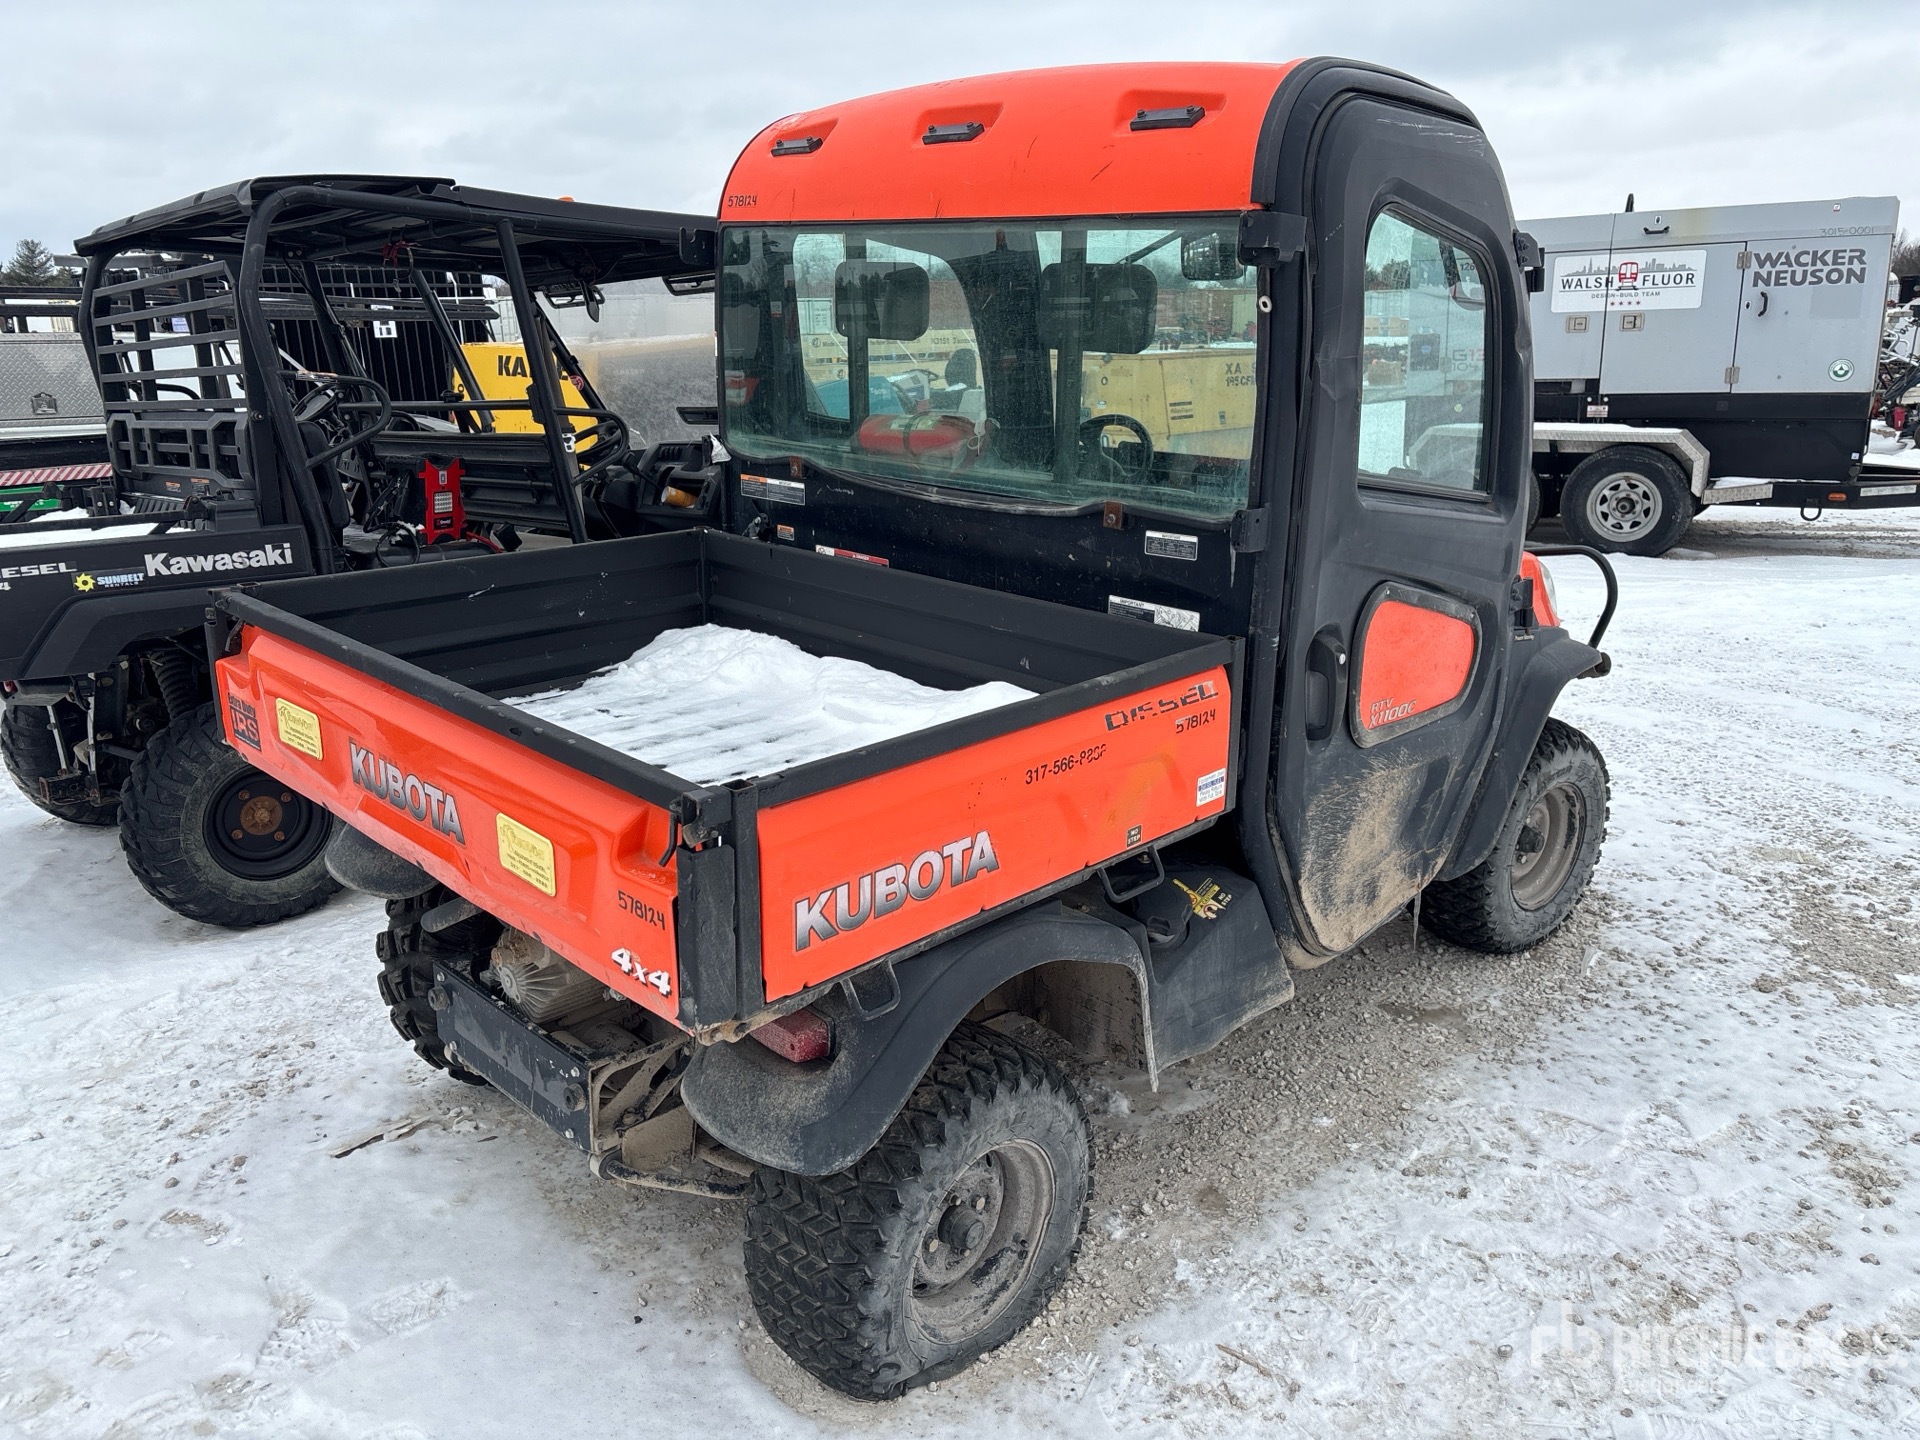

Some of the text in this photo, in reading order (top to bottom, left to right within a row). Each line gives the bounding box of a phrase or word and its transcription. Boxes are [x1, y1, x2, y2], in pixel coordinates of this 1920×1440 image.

[728, 195, 757, 207] 578124
[1819, 226, 1875, 237] 3015-0001
[1753, 248, 1867, 269] WACKER
[1561, 272, 1696, 290] WALSH FLUOR
[1752, 267, 1866, 288] NEUSON
[0, 562, 77, 578] ESEL
[144, 542, 293, 577] Kawasaki
[97, 572, 145, 585] SUNBELT
[1368, 700, 1417, 729] X1100C
[1370, 697, 1395, 713] RTV
[231, 709, 259, 742] IRS
[1175, 708, 1217, 734] 578124
[349, 741, 466, 847] KUBOTA
[1127, 834, 1141, 845] STEP
[1130, 828, 1139, 836] NO
[795, 829, 1000, 952] KUBOTA
[1217, 892, 1226, 901] NO
[617, 889, 666, 931] 578124
[611, 947, 672, 999] 4x4
